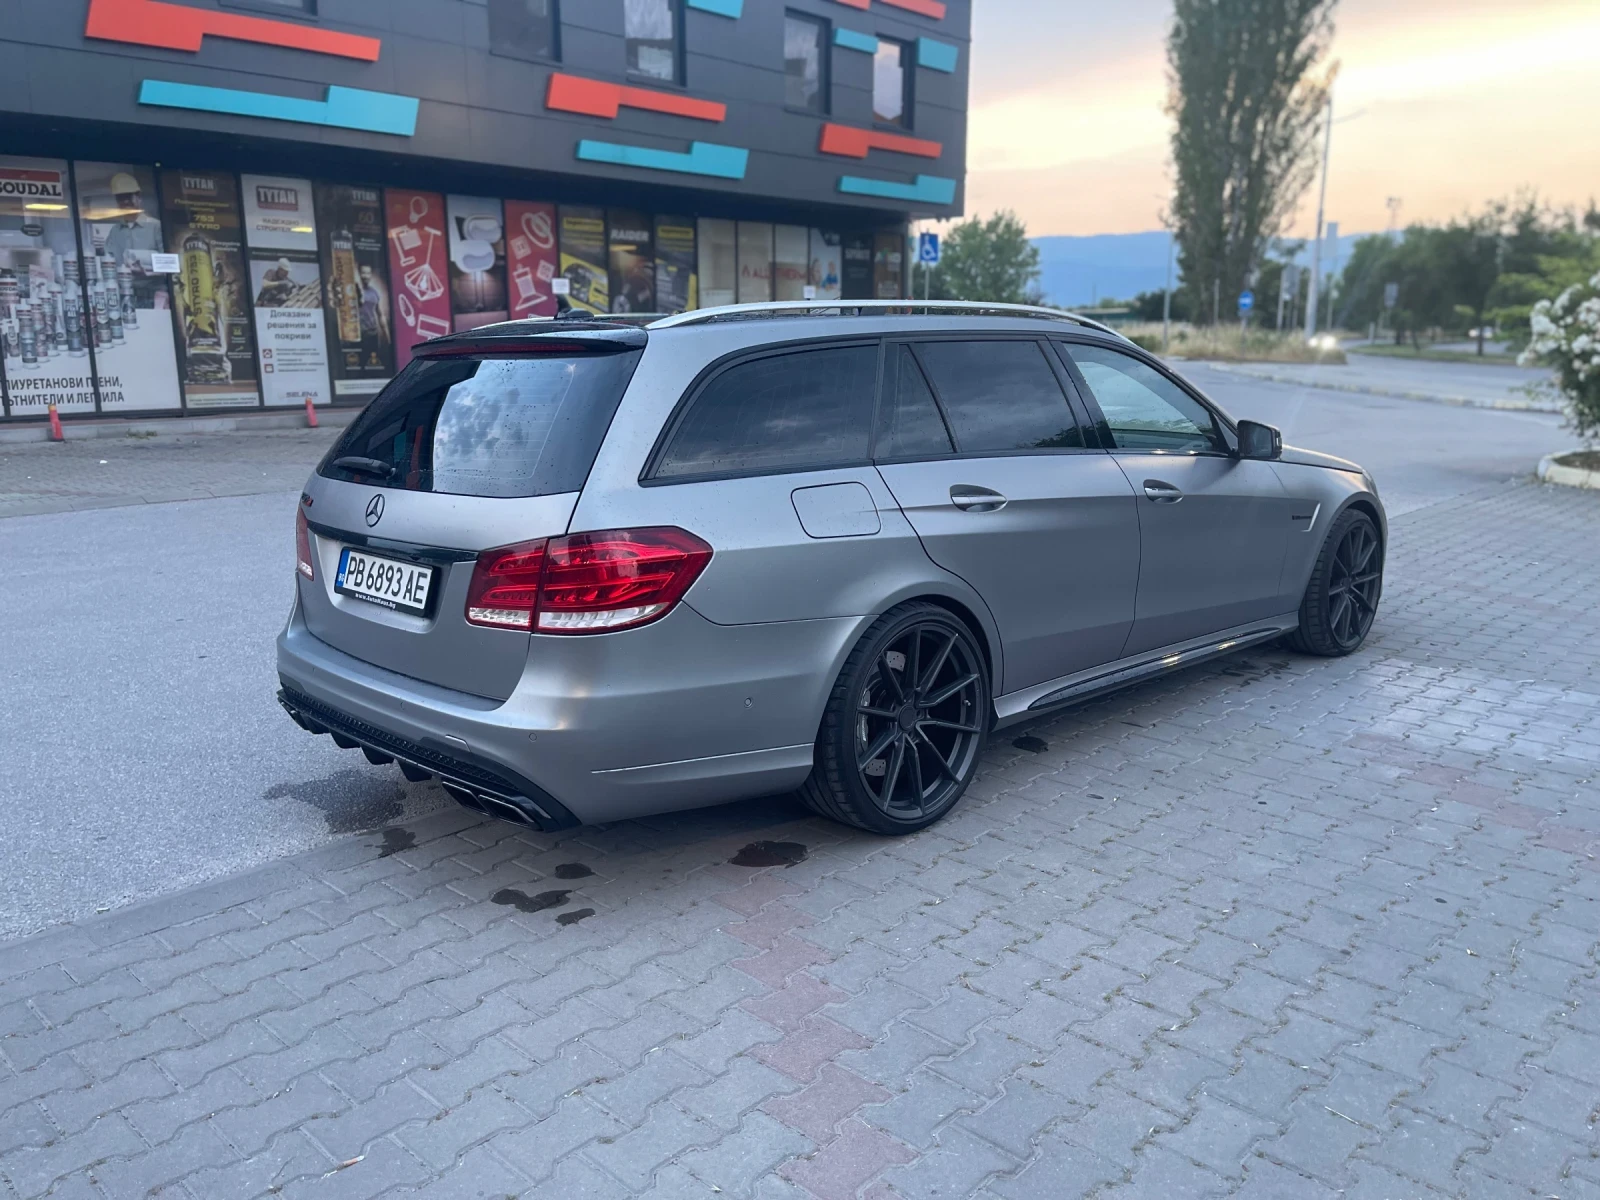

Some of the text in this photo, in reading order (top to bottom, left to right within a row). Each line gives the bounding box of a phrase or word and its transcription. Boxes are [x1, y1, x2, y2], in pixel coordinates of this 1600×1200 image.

[258, 188, 296, 205] TYTAN
[275, 333, 311, 341] покриви
[66, 393, 75, 404] И
